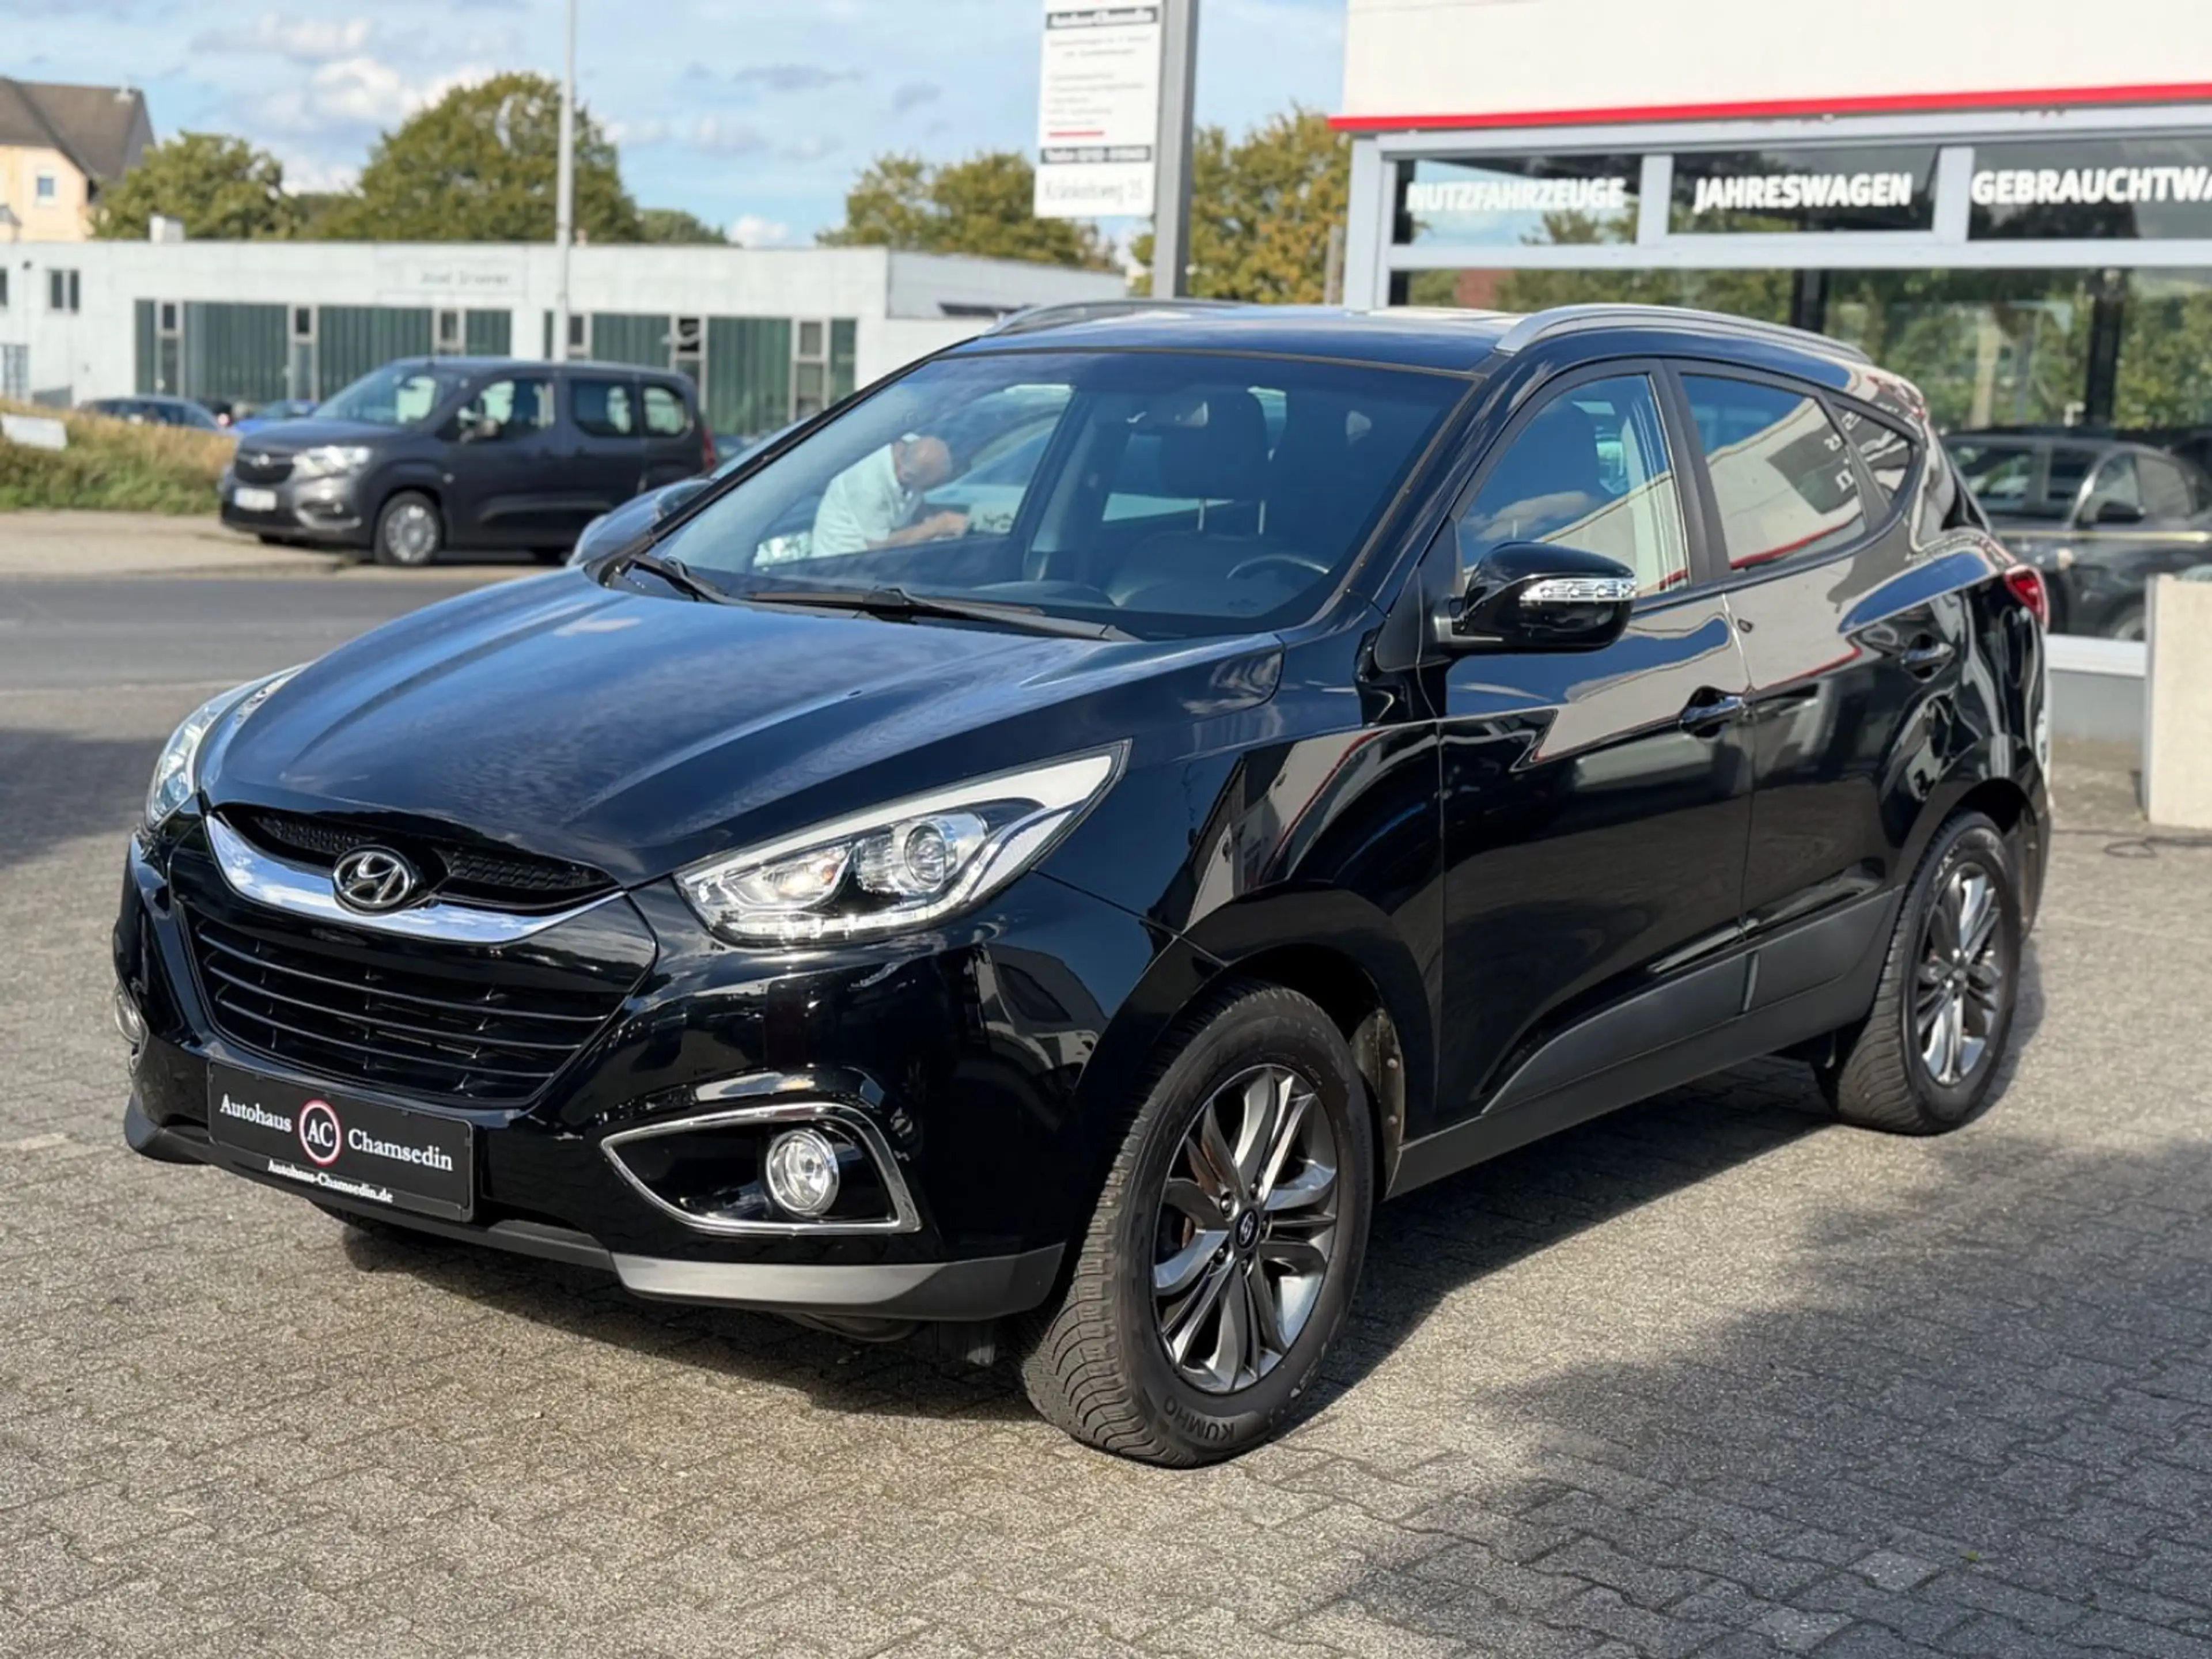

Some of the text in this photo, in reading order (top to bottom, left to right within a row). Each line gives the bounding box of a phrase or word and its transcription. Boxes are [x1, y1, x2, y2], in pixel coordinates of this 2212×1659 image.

[1406, 176, 1627, 212] NUTZFAHRZEUGE
[1692, 172, 1914, 214] JAHRESWAGEN
[220, 1093, 453, 1171] Autohaus AC Chamsedin
[267, 1160, 393, 1203] Autohaus-Chamsedin.de
[1164, 1395, 1235, 1441] KUMHO
